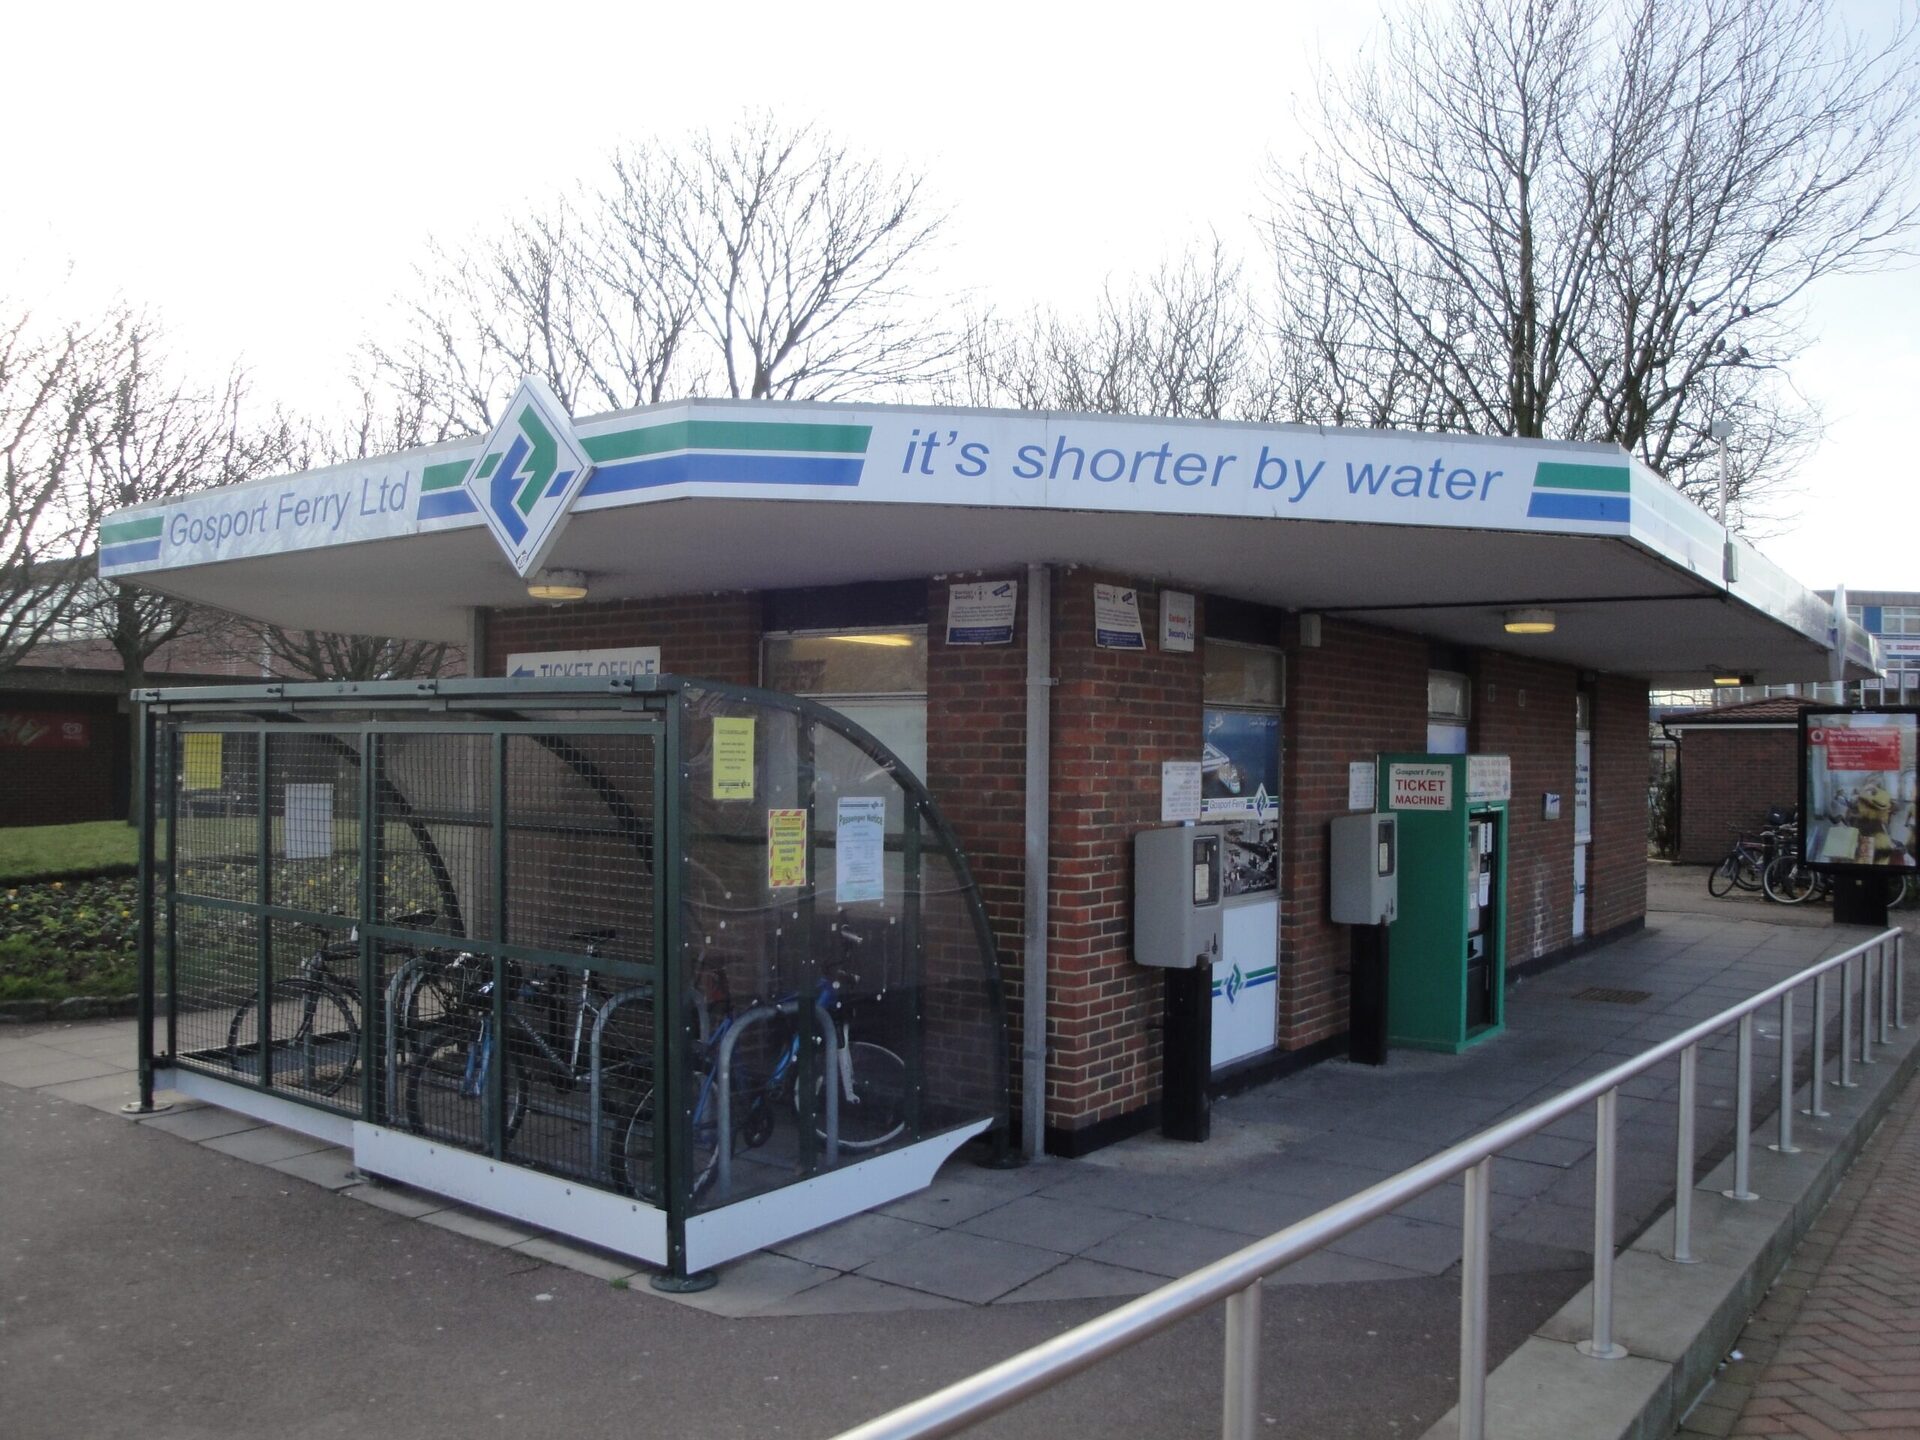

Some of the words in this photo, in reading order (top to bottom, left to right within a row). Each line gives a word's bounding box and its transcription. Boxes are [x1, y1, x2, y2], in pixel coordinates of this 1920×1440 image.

[902, 428, 990, 478] it's
[1012, 434, 1237, 487] shorter
[1253, 444, 1327, 504] by
[1346, 457, 1505, 502] water
[170, 499, 268, 549] Gosport
[276, 491, 351, 531] Ferry
[360, 470, 410, 516] Ltd
[540, 662, 593, 677] TICKET
[598, 659, 655, 676] OFFICE
[1395, 768, 1424, 777] Gosport
[1426, 768, 1445, 777] Ferry
[1395, 779, 1446, 792] TICKET
[1209, 799, 1231, 810] Gosport
[1395, 795, 1445, 806] MACHINE
